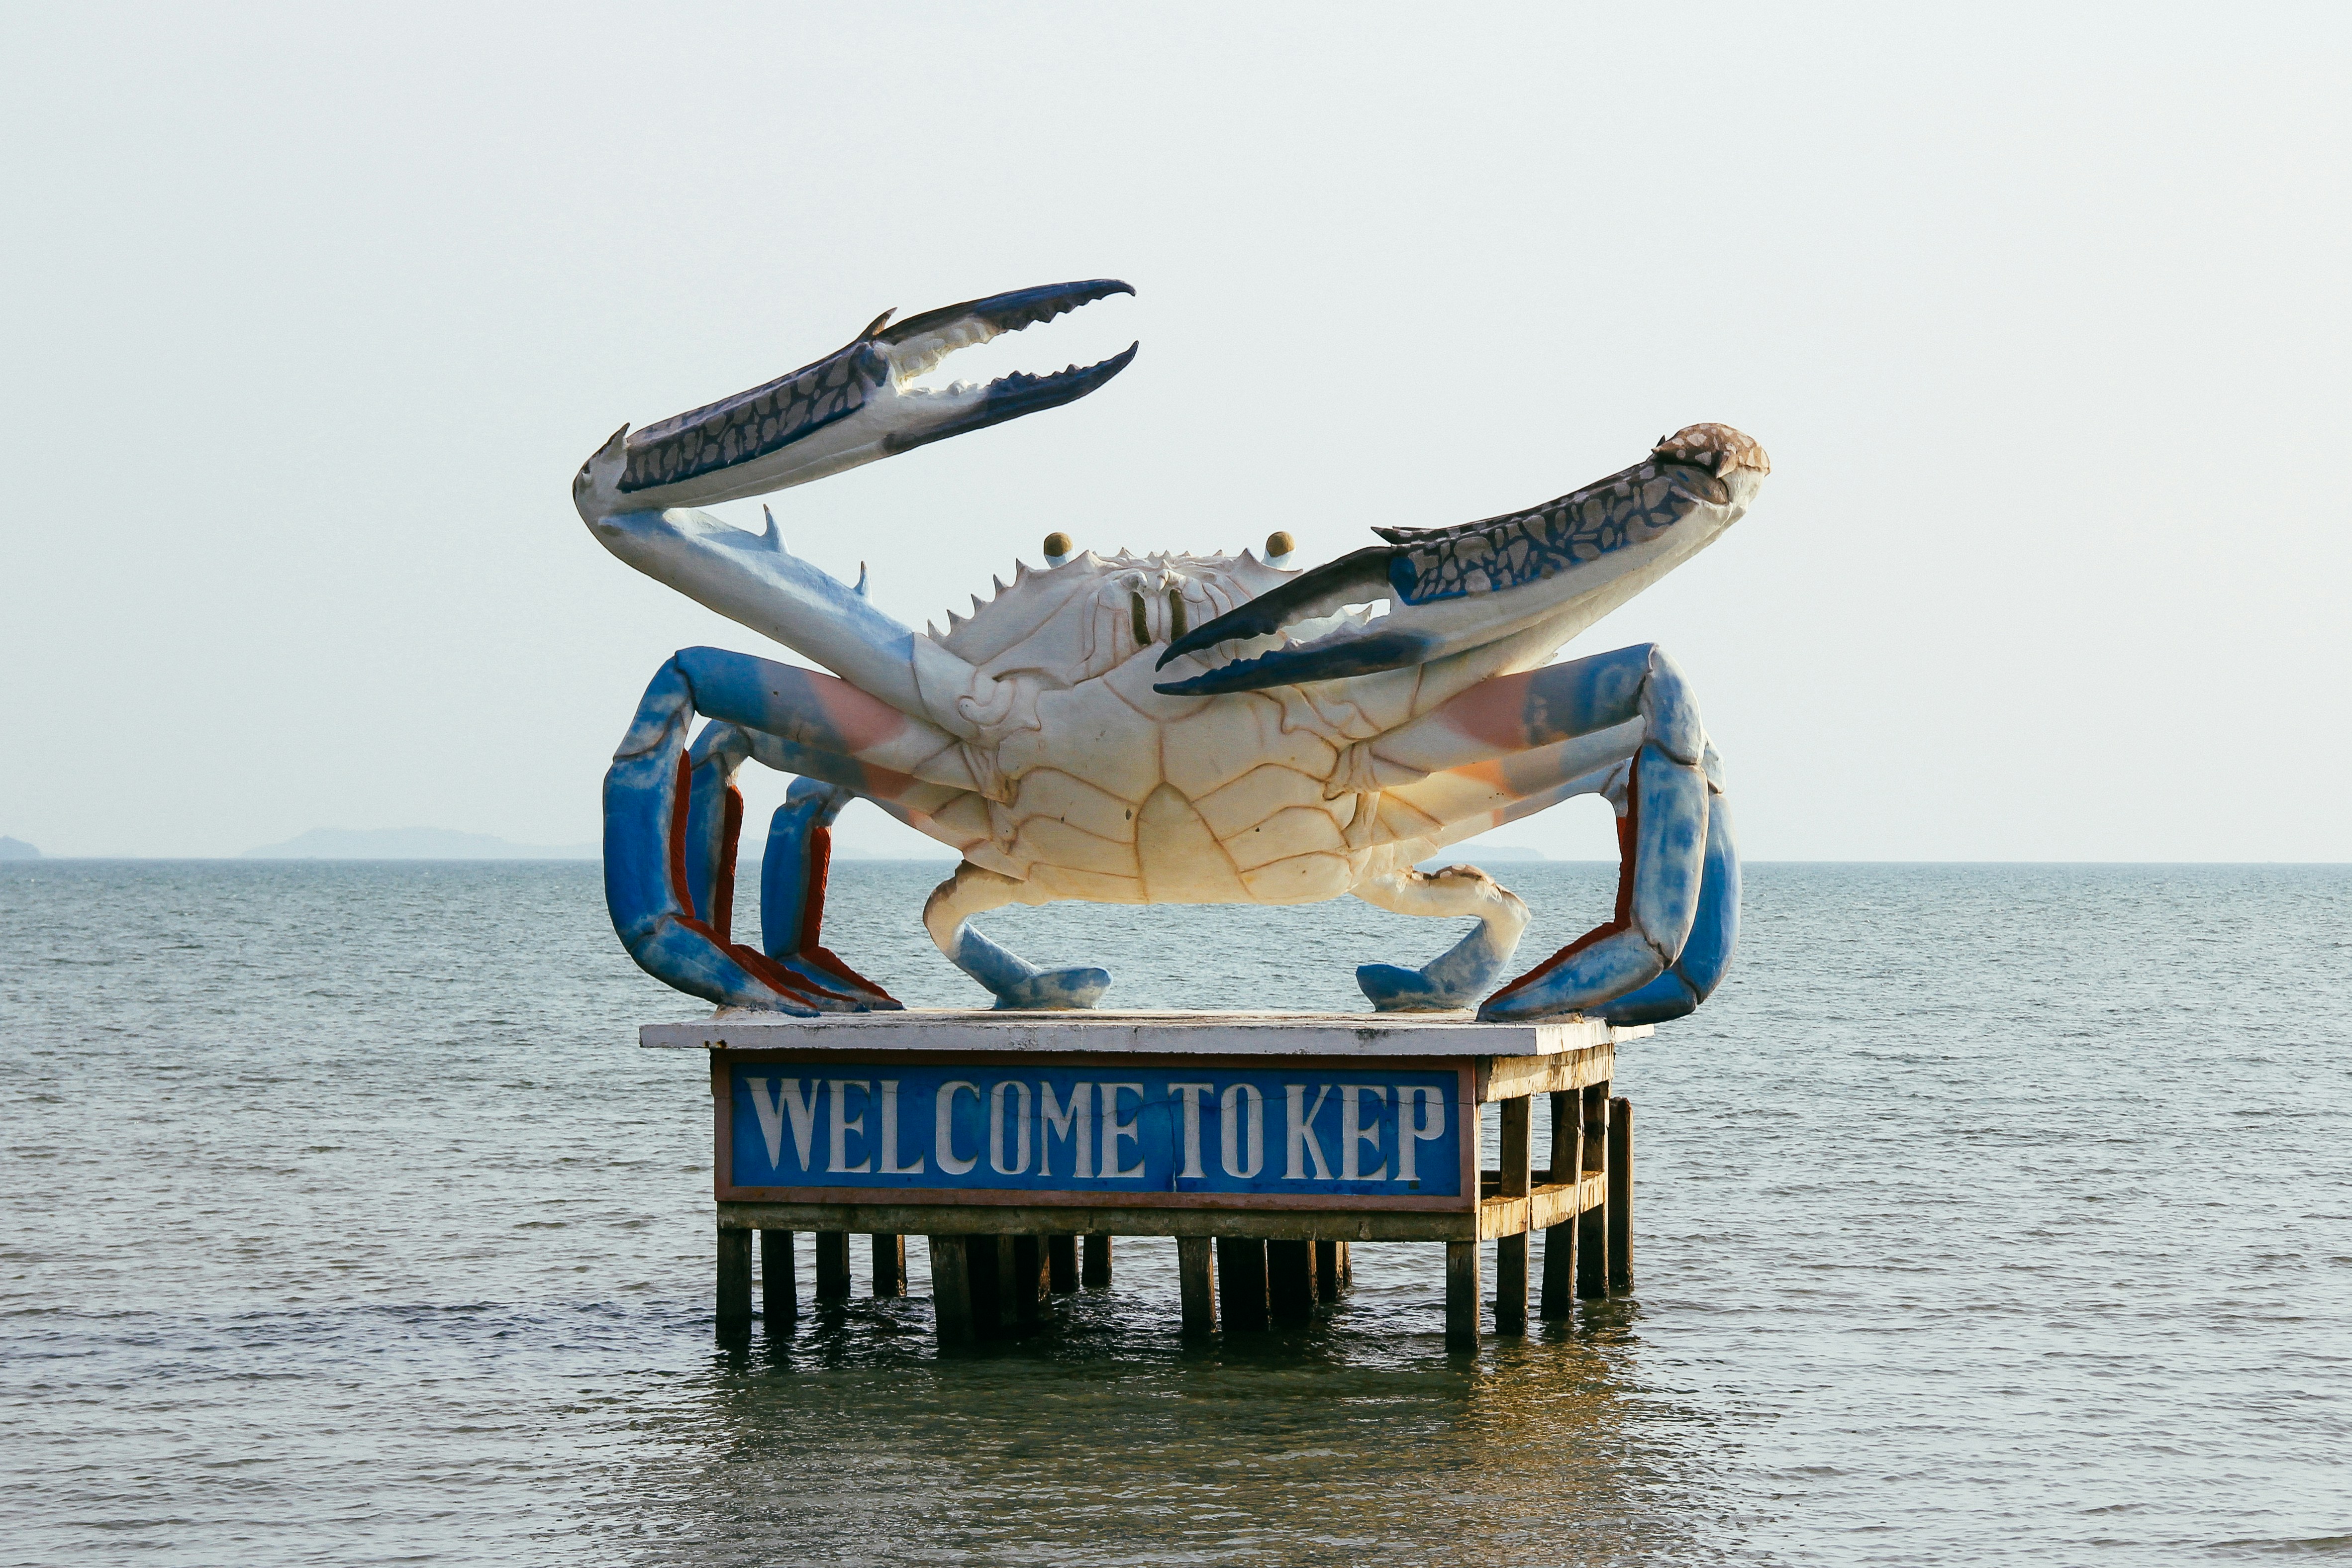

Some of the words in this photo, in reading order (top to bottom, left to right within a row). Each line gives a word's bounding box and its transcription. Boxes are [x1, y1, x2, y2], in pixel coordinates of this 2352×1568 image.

[745, 1078, 1145, 1178] WELCOME
[1168, 1082, 1264, 1179] TO
[1282, 1084, 1445, 1181] KEP
